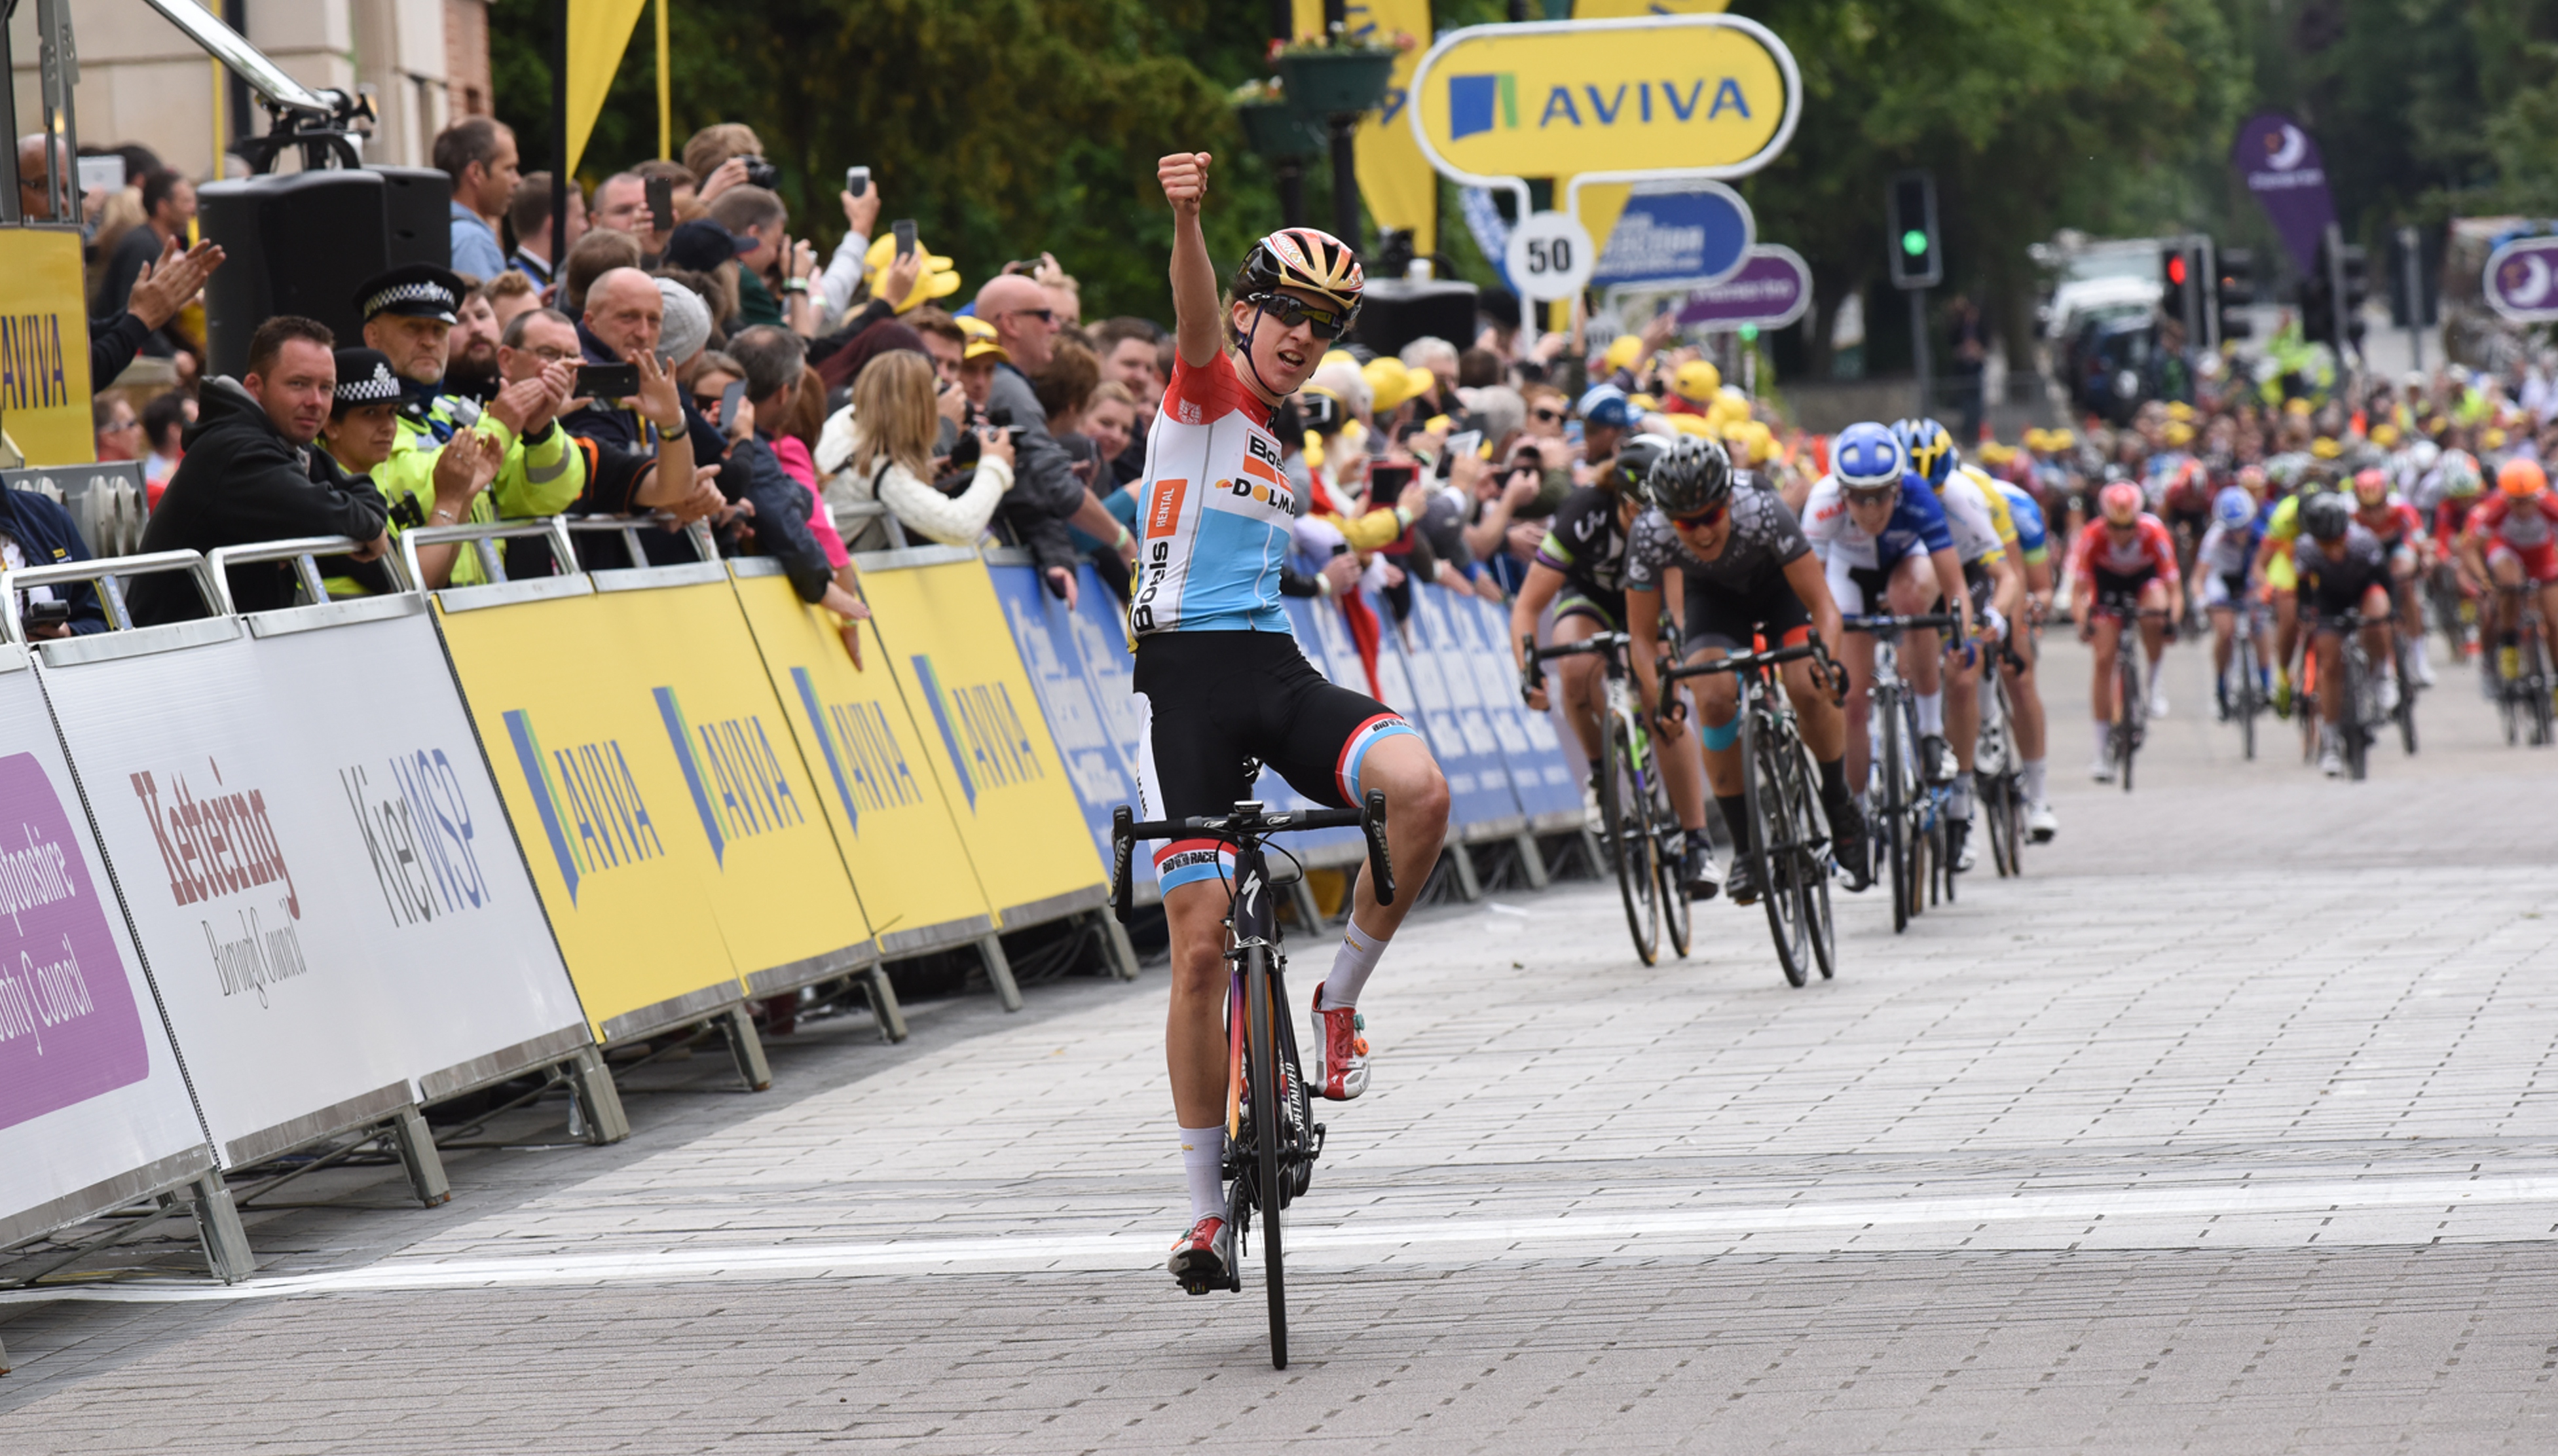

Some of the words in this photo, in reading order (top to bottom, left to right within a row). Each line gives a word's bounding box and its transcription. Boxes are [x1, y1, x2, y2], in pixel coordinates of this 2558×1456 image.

[1539, 77, 1751, 128] AVIVA
[1529, 238, 1570, 274] 50
[1, 314, 67, 410] AVIVA
[1250, 435, 1286, 471] Boe
[1134, 541, 1169, 631] Boels
[1156, 488, 1175, 528] RENTAL
[698, 716, 806, 839] AVIVA
[830, 700, 924, 812] AVIVA
[952, 682, 1045, 790] AVIVA
[130, 755, 301, 920] Kettering
[339, 748, 491, 928] KierWSP
[553, 739, 665, 873] AVIVA
[21, 932, 94, 1028] Council
[201, 909, 269, 1010] Borough
[1286, 1062, 1304, 1132] SPECIALIZED
